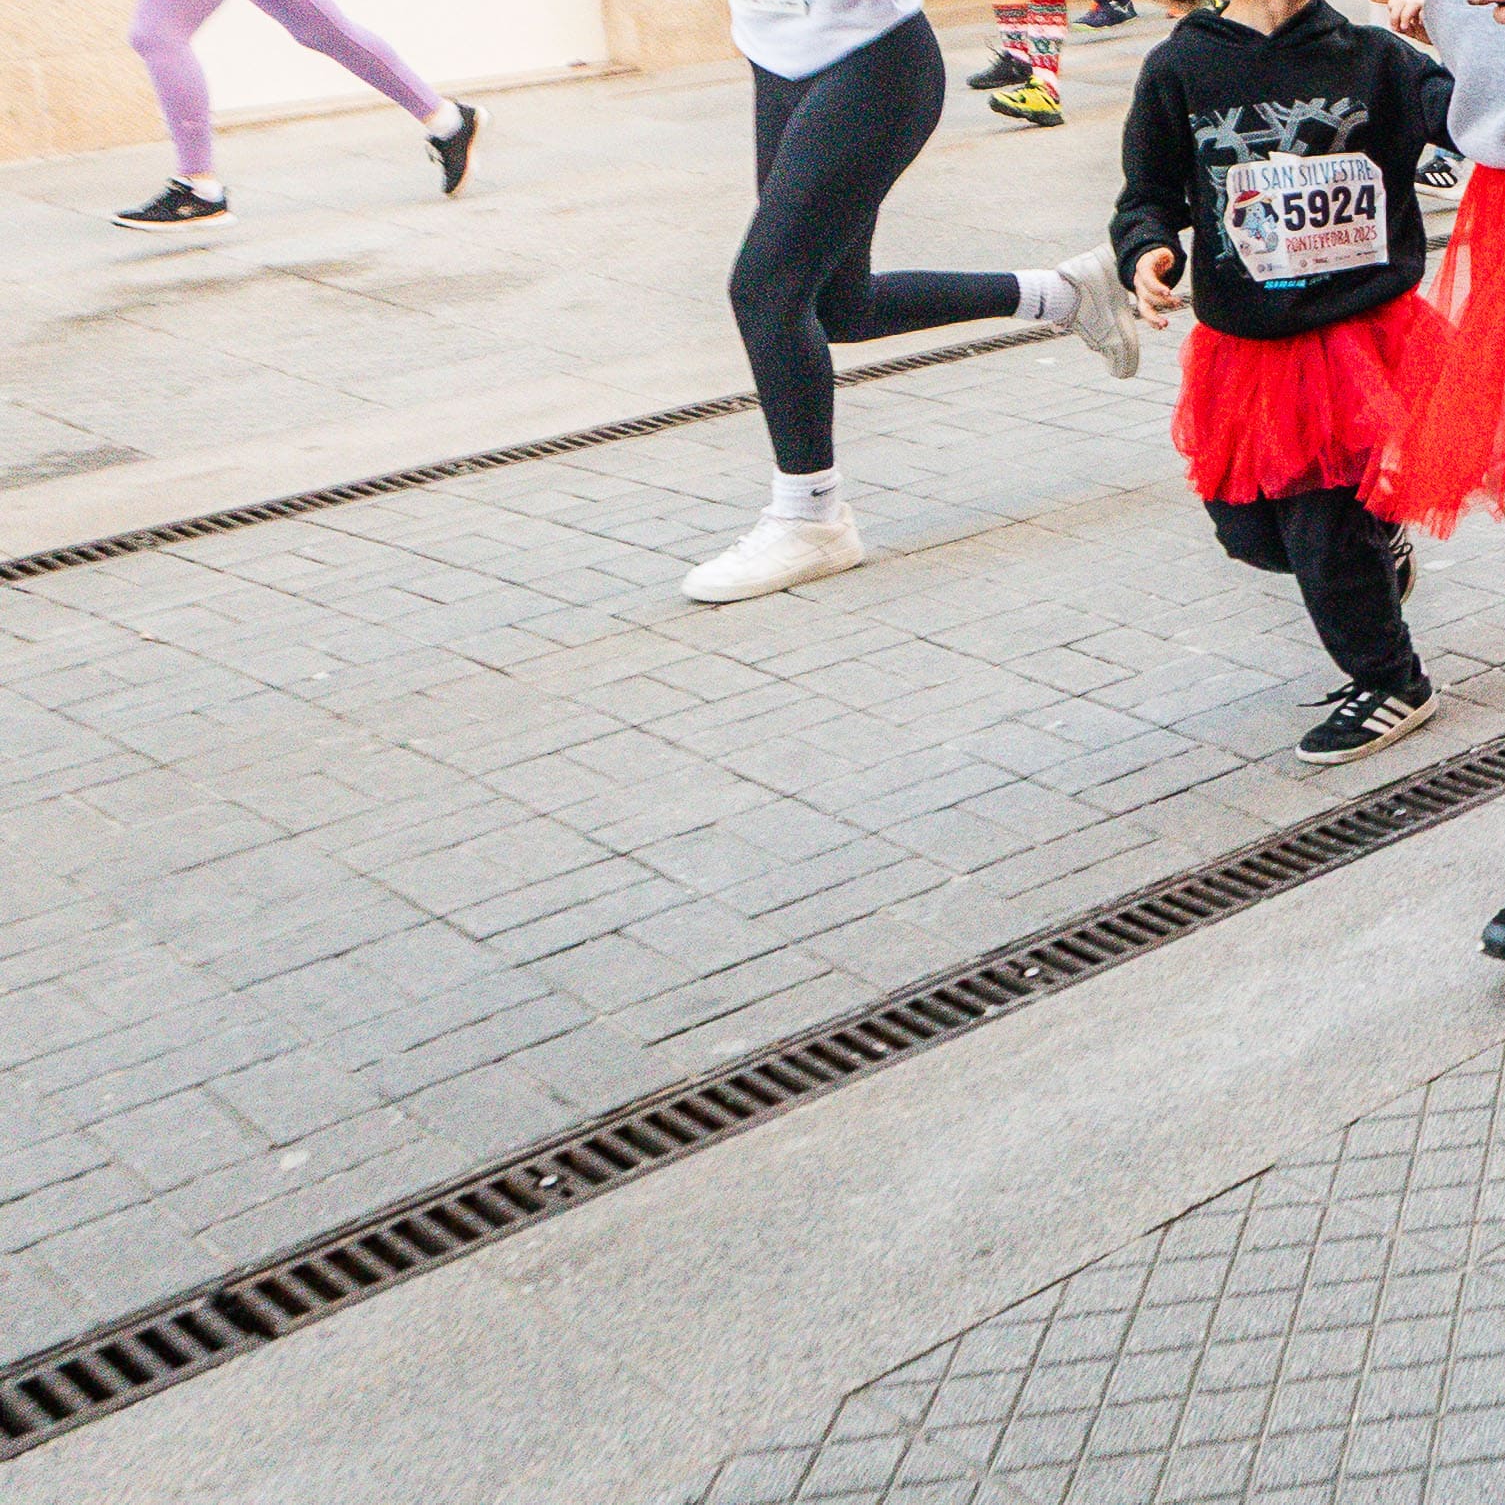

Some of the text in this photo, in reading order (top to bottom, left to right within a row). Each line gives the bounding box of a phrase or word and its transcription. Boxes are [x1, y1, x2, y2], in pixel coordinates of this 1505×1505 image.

[1262, 165, 1295, 192] SAN
[1299, 158, 1374, 188] SILVESTRE
[1282, 184, 1378, 232] 5924
[1285, 224, 1378, 253] PONTEVEDRA 2025
